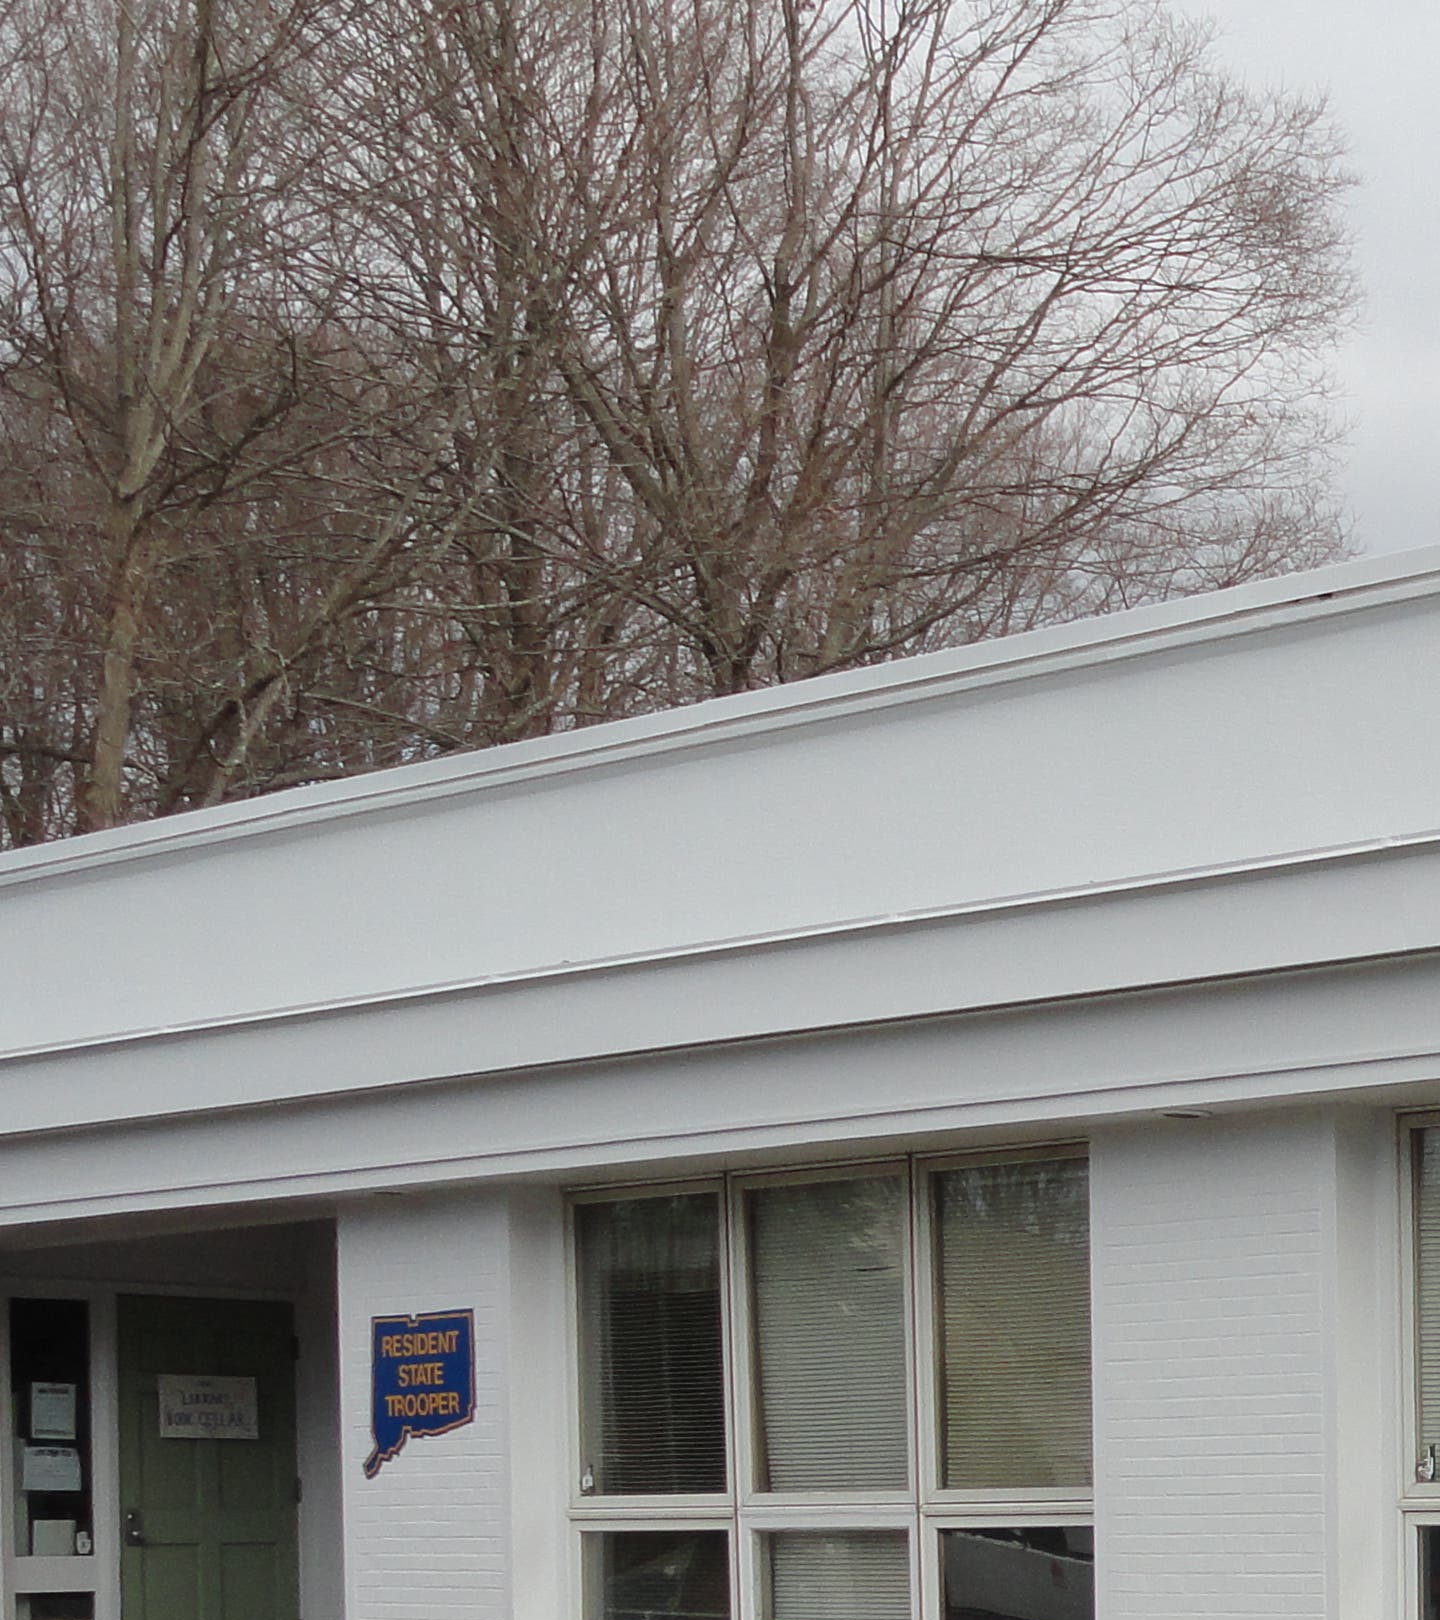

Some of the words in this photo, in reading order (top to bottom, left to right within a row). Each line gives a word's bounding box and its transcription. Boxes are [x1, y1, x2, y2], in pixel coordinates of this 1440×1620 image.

[382, 1330, 459, 1358] RESIDENT
[398, 1362, 444, 1387] STATE
[384, 1391, 460, 1417] TROOPER
